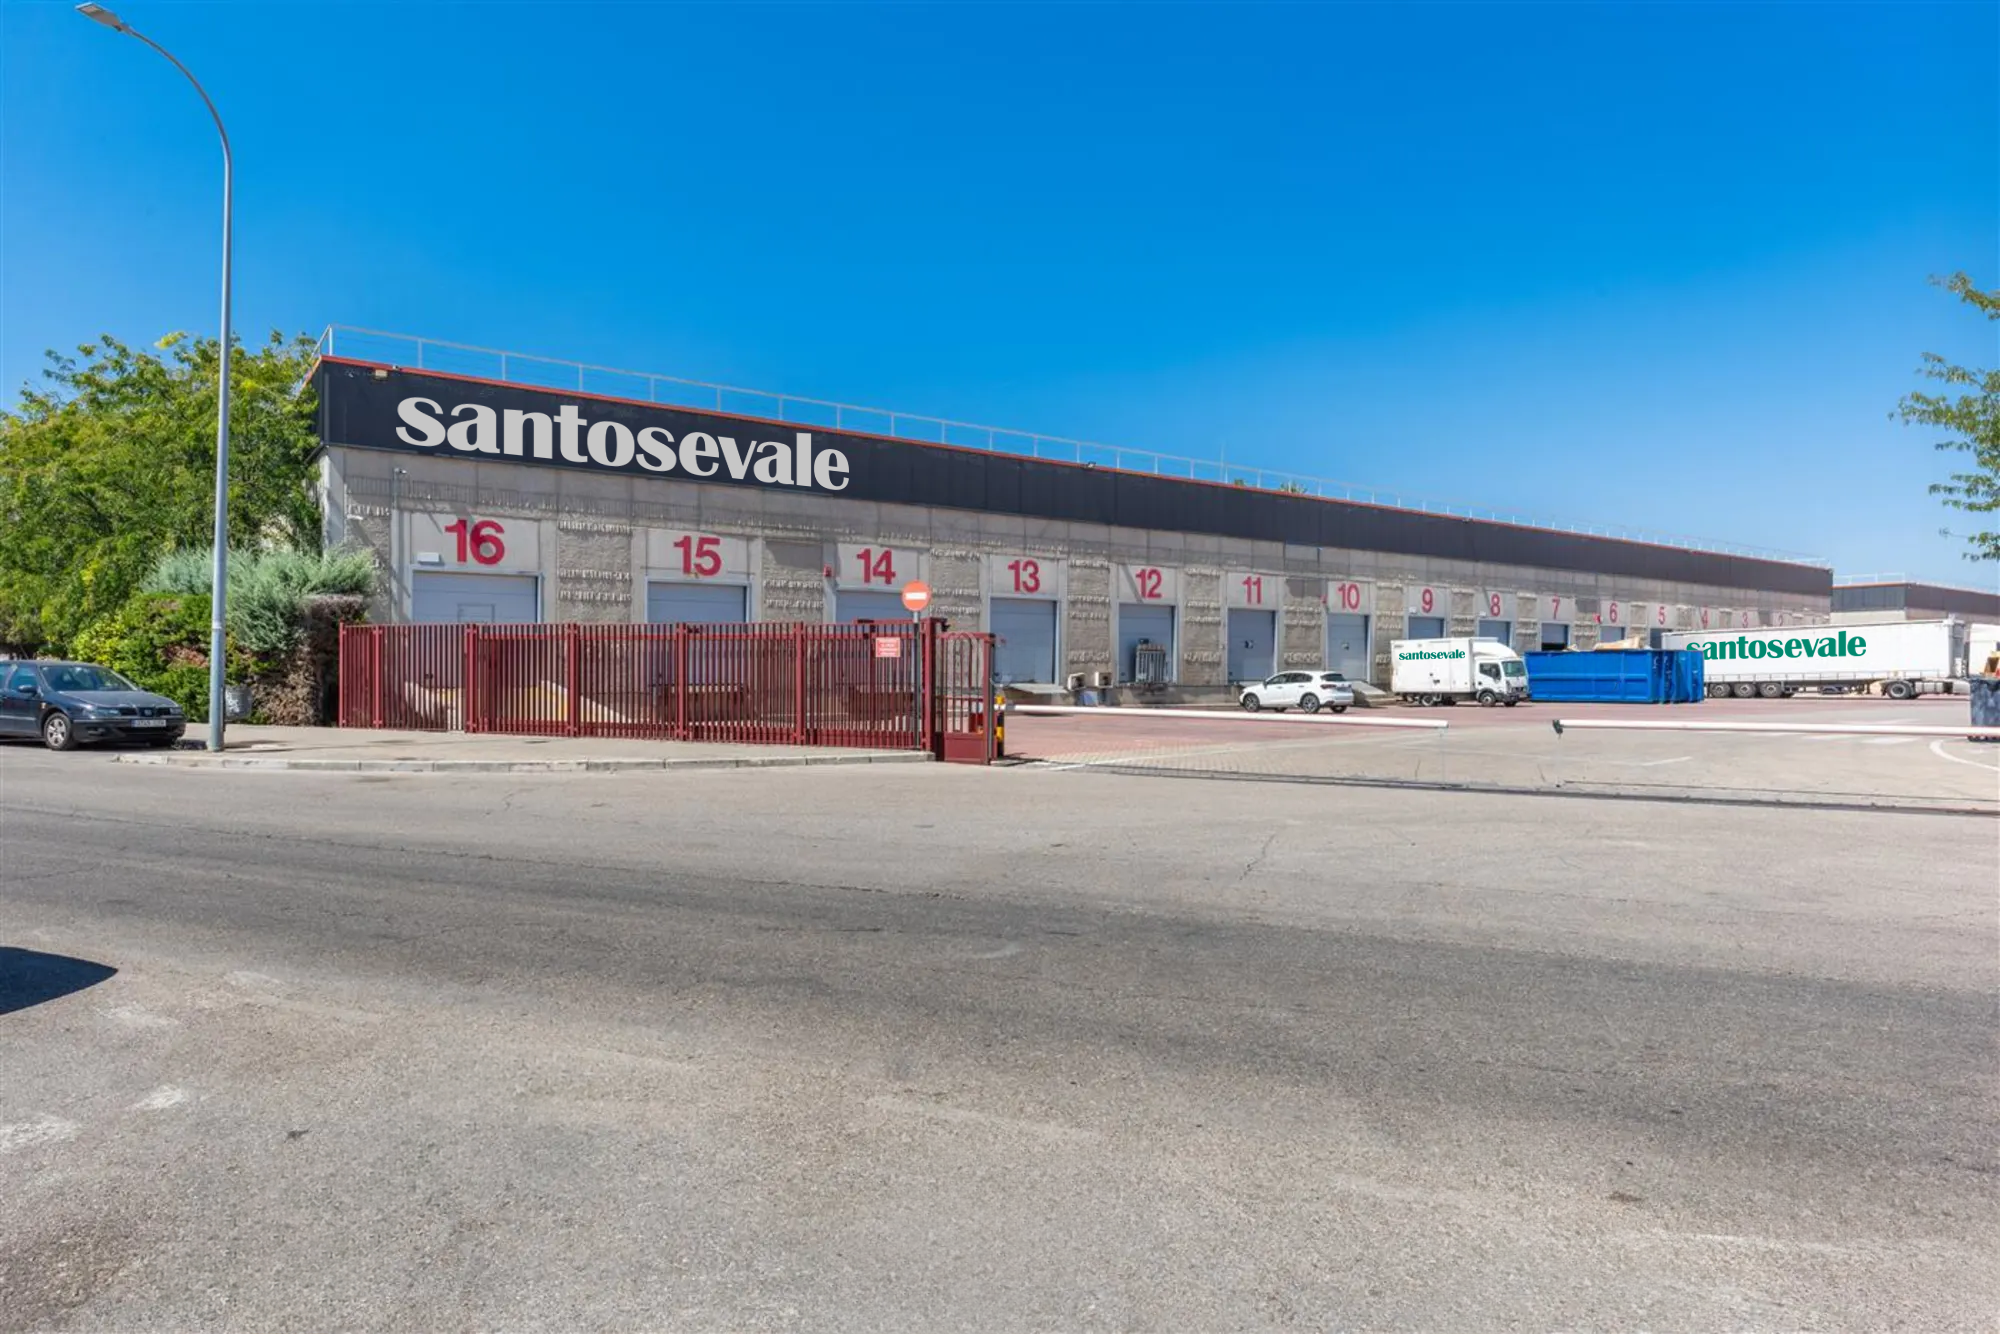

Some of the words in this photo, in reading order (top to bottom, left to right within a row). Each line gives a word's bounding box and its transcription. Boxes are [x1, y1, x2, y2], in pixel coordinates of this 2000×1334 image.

[395, 396, 850, 491] santosevale
[444, 519, 506, 566] 16
[674, 535, 722, 577] 15
[857, 547, 897, 585] 14
[1007, 558, 1041, 594] 13
[1136, 567, 1163, 599] 12
[1242, 575, 1263, 605] 11
[1337, 582, 1361, 612] 10
[1422, 588, 1433, 612] 9
[1490, 593, 1502, 616] 8
[1552, 598, 1560, 619] 7
[1609, 603, 1618, 623] 6
[1658, 606, 1665, 625] 5
[1398, 648, 1466, 661] santosevale
